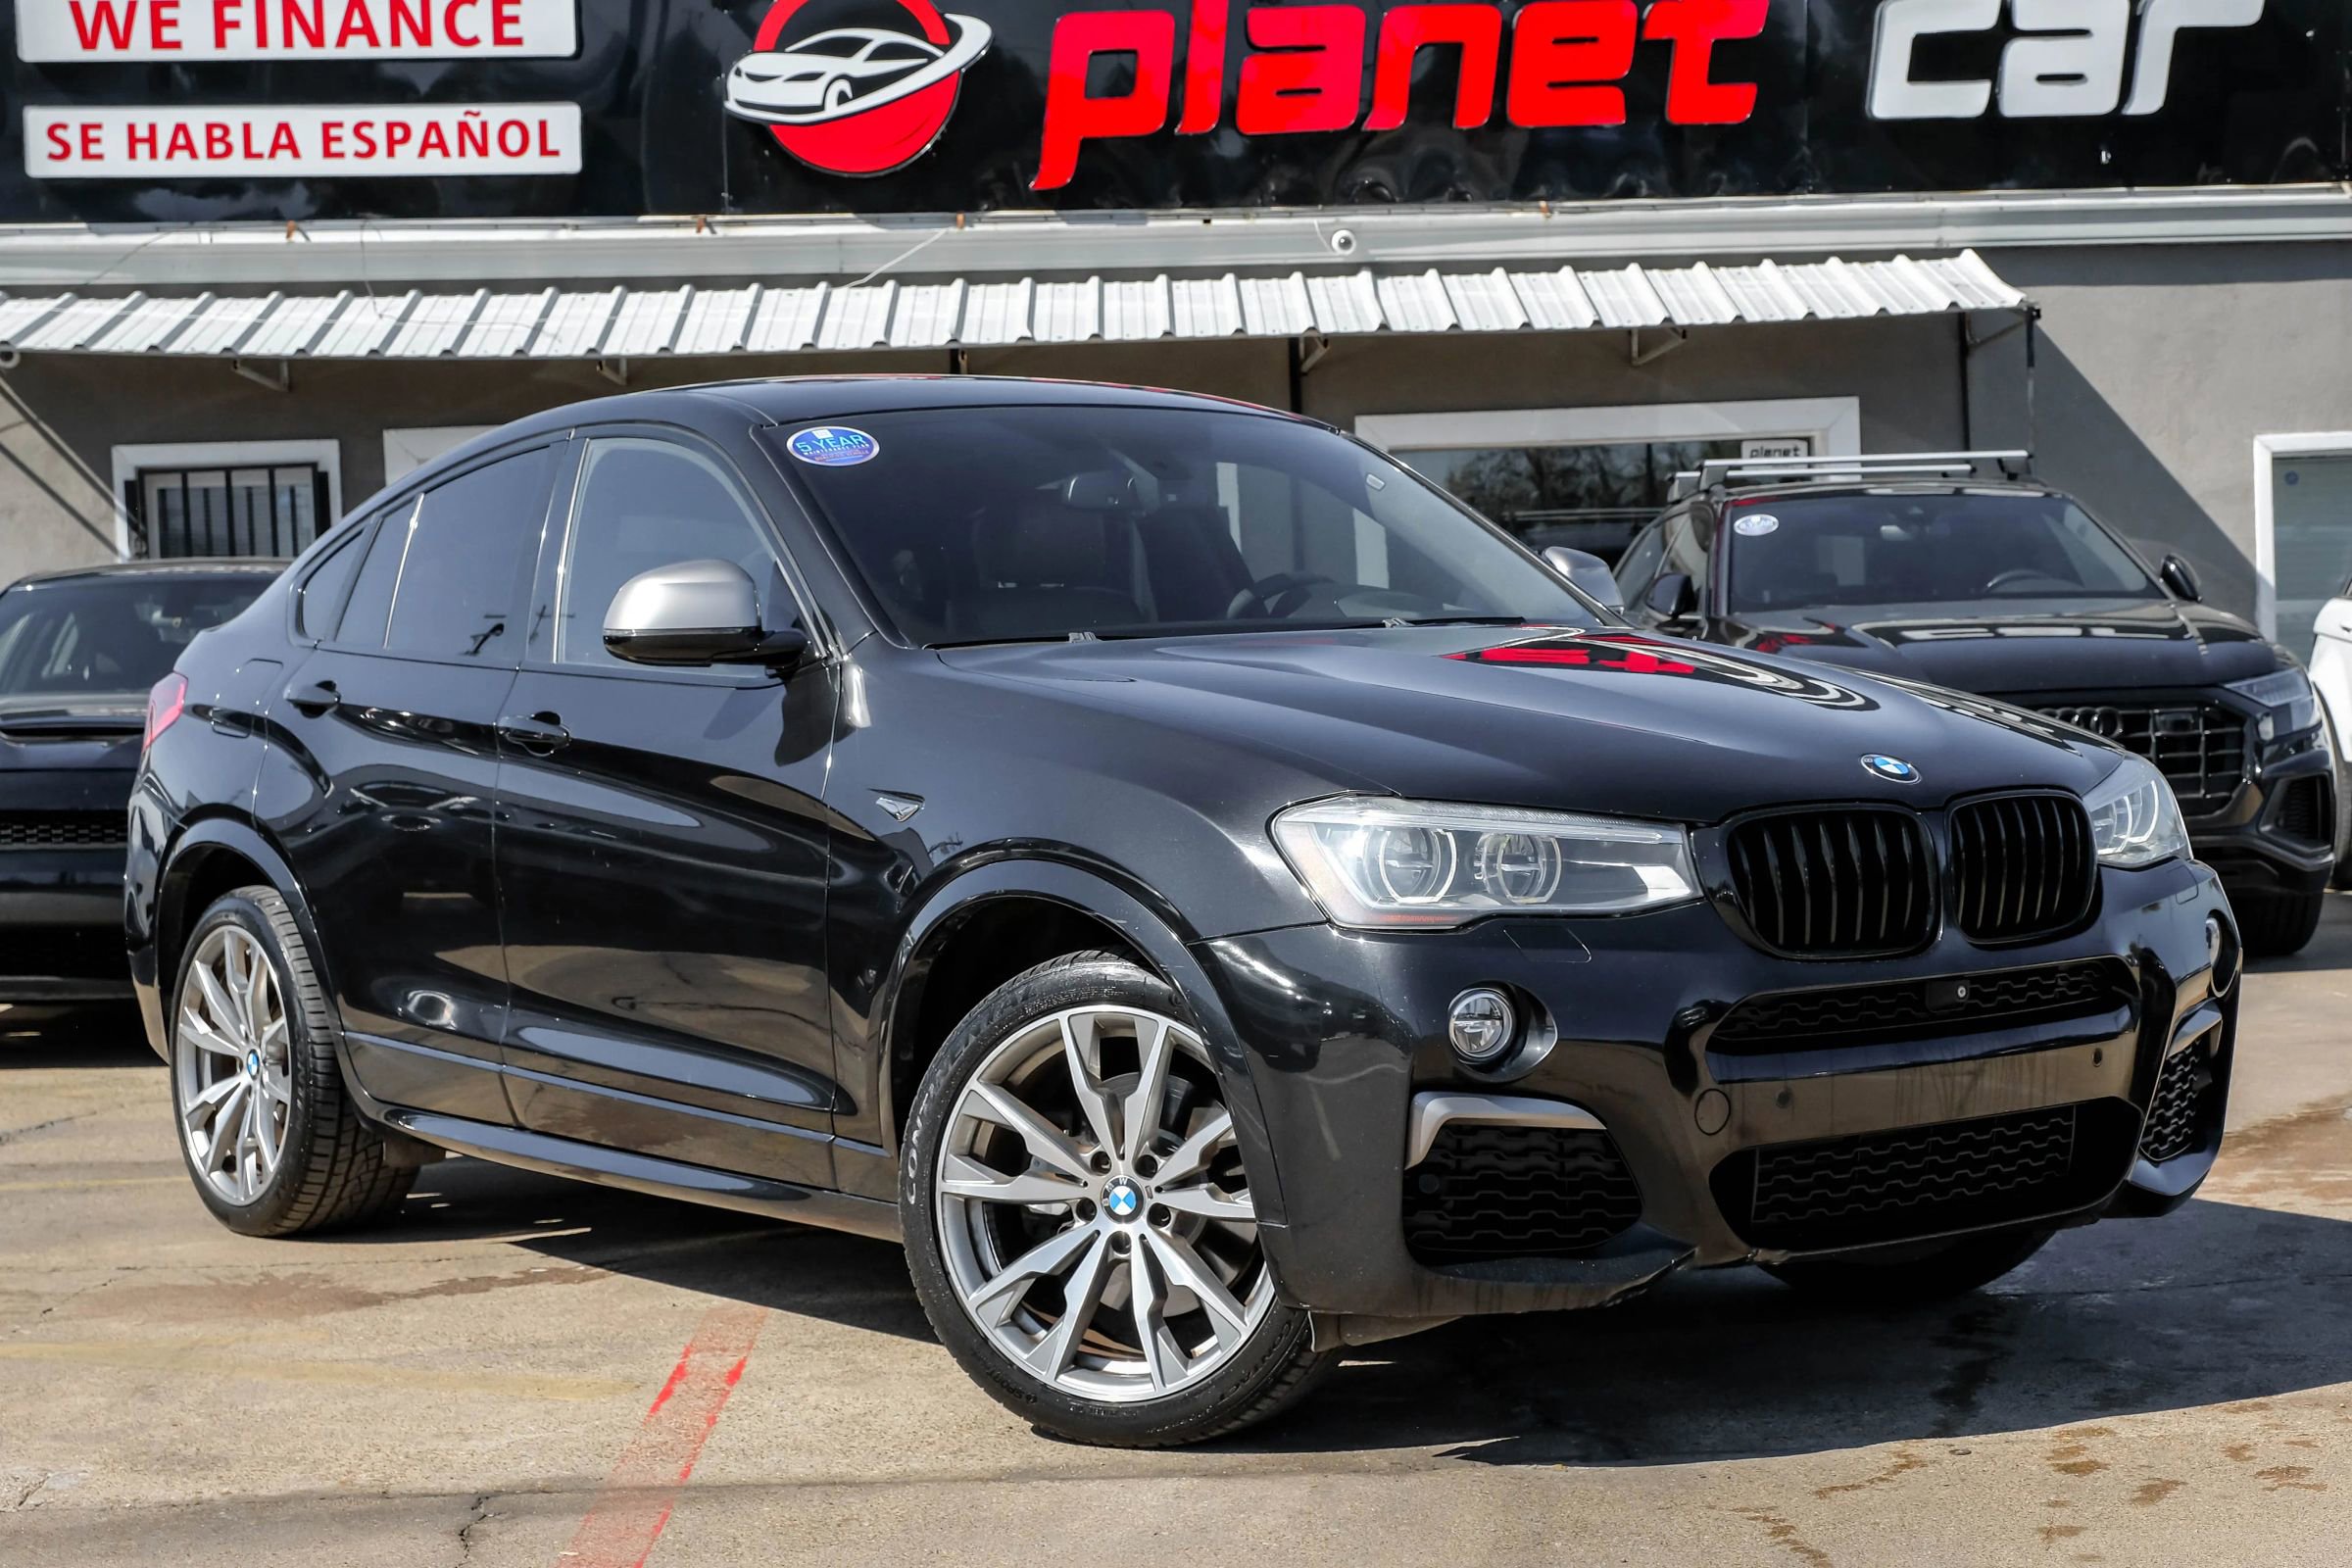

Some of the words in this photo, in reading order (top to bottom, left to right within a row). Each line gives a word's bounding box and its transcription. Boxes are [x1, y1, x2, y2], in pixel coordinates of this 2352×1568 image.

[69, 0, 182, 50] WE
[213, 0, 523, 49] FINANCE
[1866, 0, 2266, 119] car
[1030, 0, 1771, 192] planet
[46, 122, 104, 161] SE
[127, 122, 301, 160] HABLA
[321, 110, 561, 159] ESPAÑOL
[796, 441, 813, 452] 5
[812, 434, 867, 450] YEAR
[1749, 444, 1801, 459] planet
